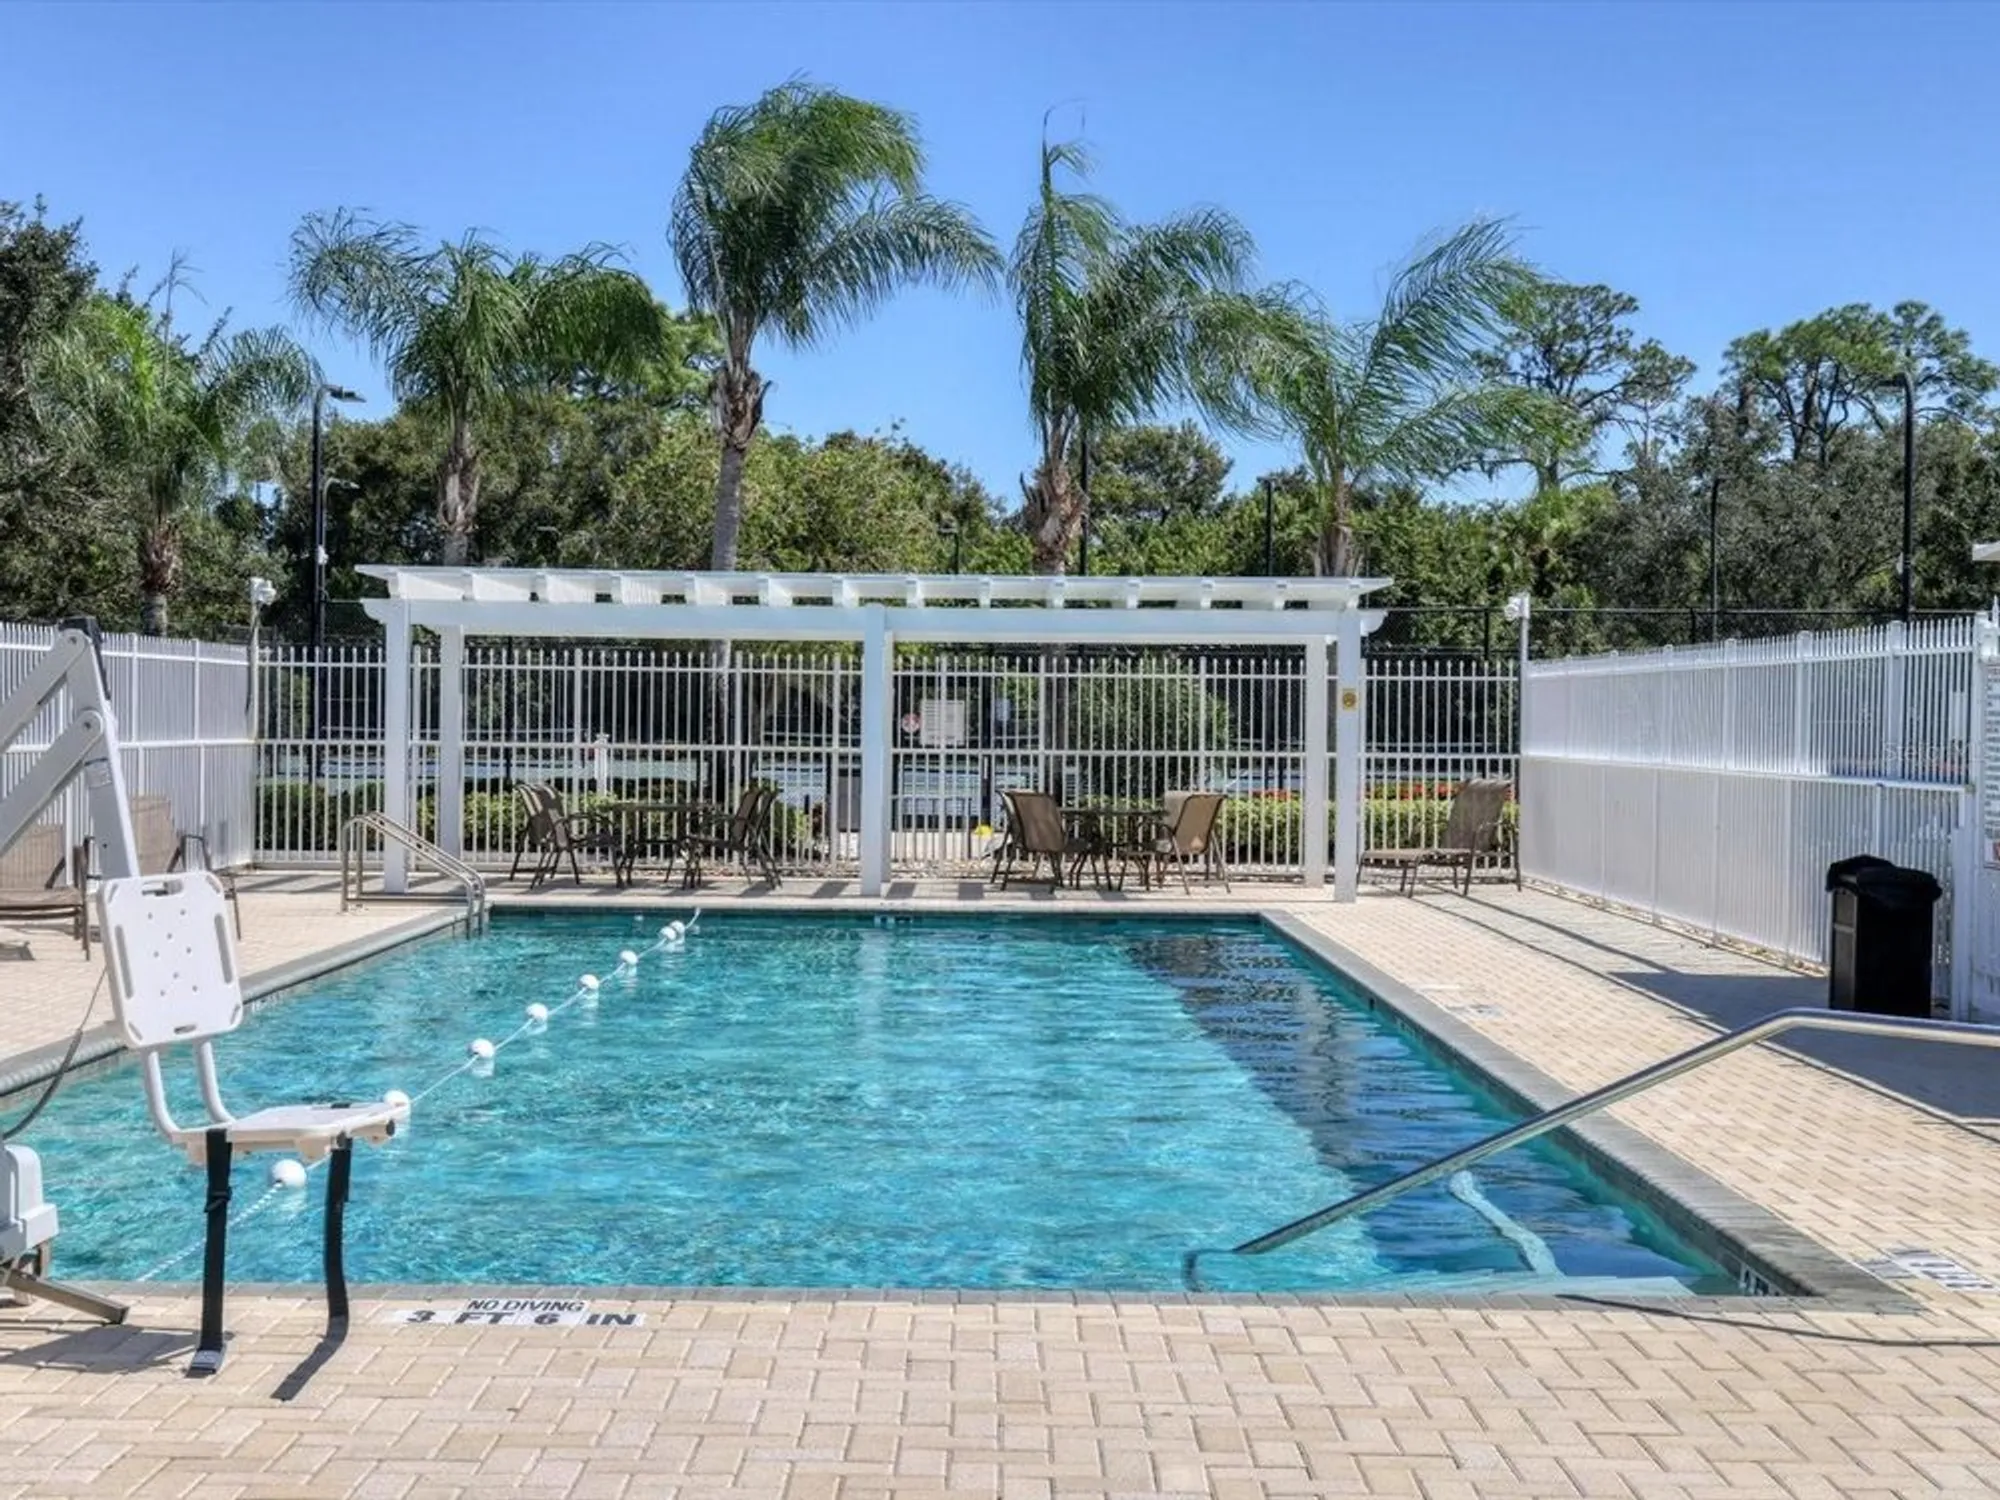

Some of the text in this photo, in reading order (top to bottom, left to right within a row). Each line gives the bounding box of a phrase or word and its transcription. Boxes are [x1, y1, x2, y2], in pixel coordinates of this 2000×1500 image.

[467, 1299, 584, 1312] NO DIVING
[406, 1310, 637, 1326] 3 FT 6 IN
